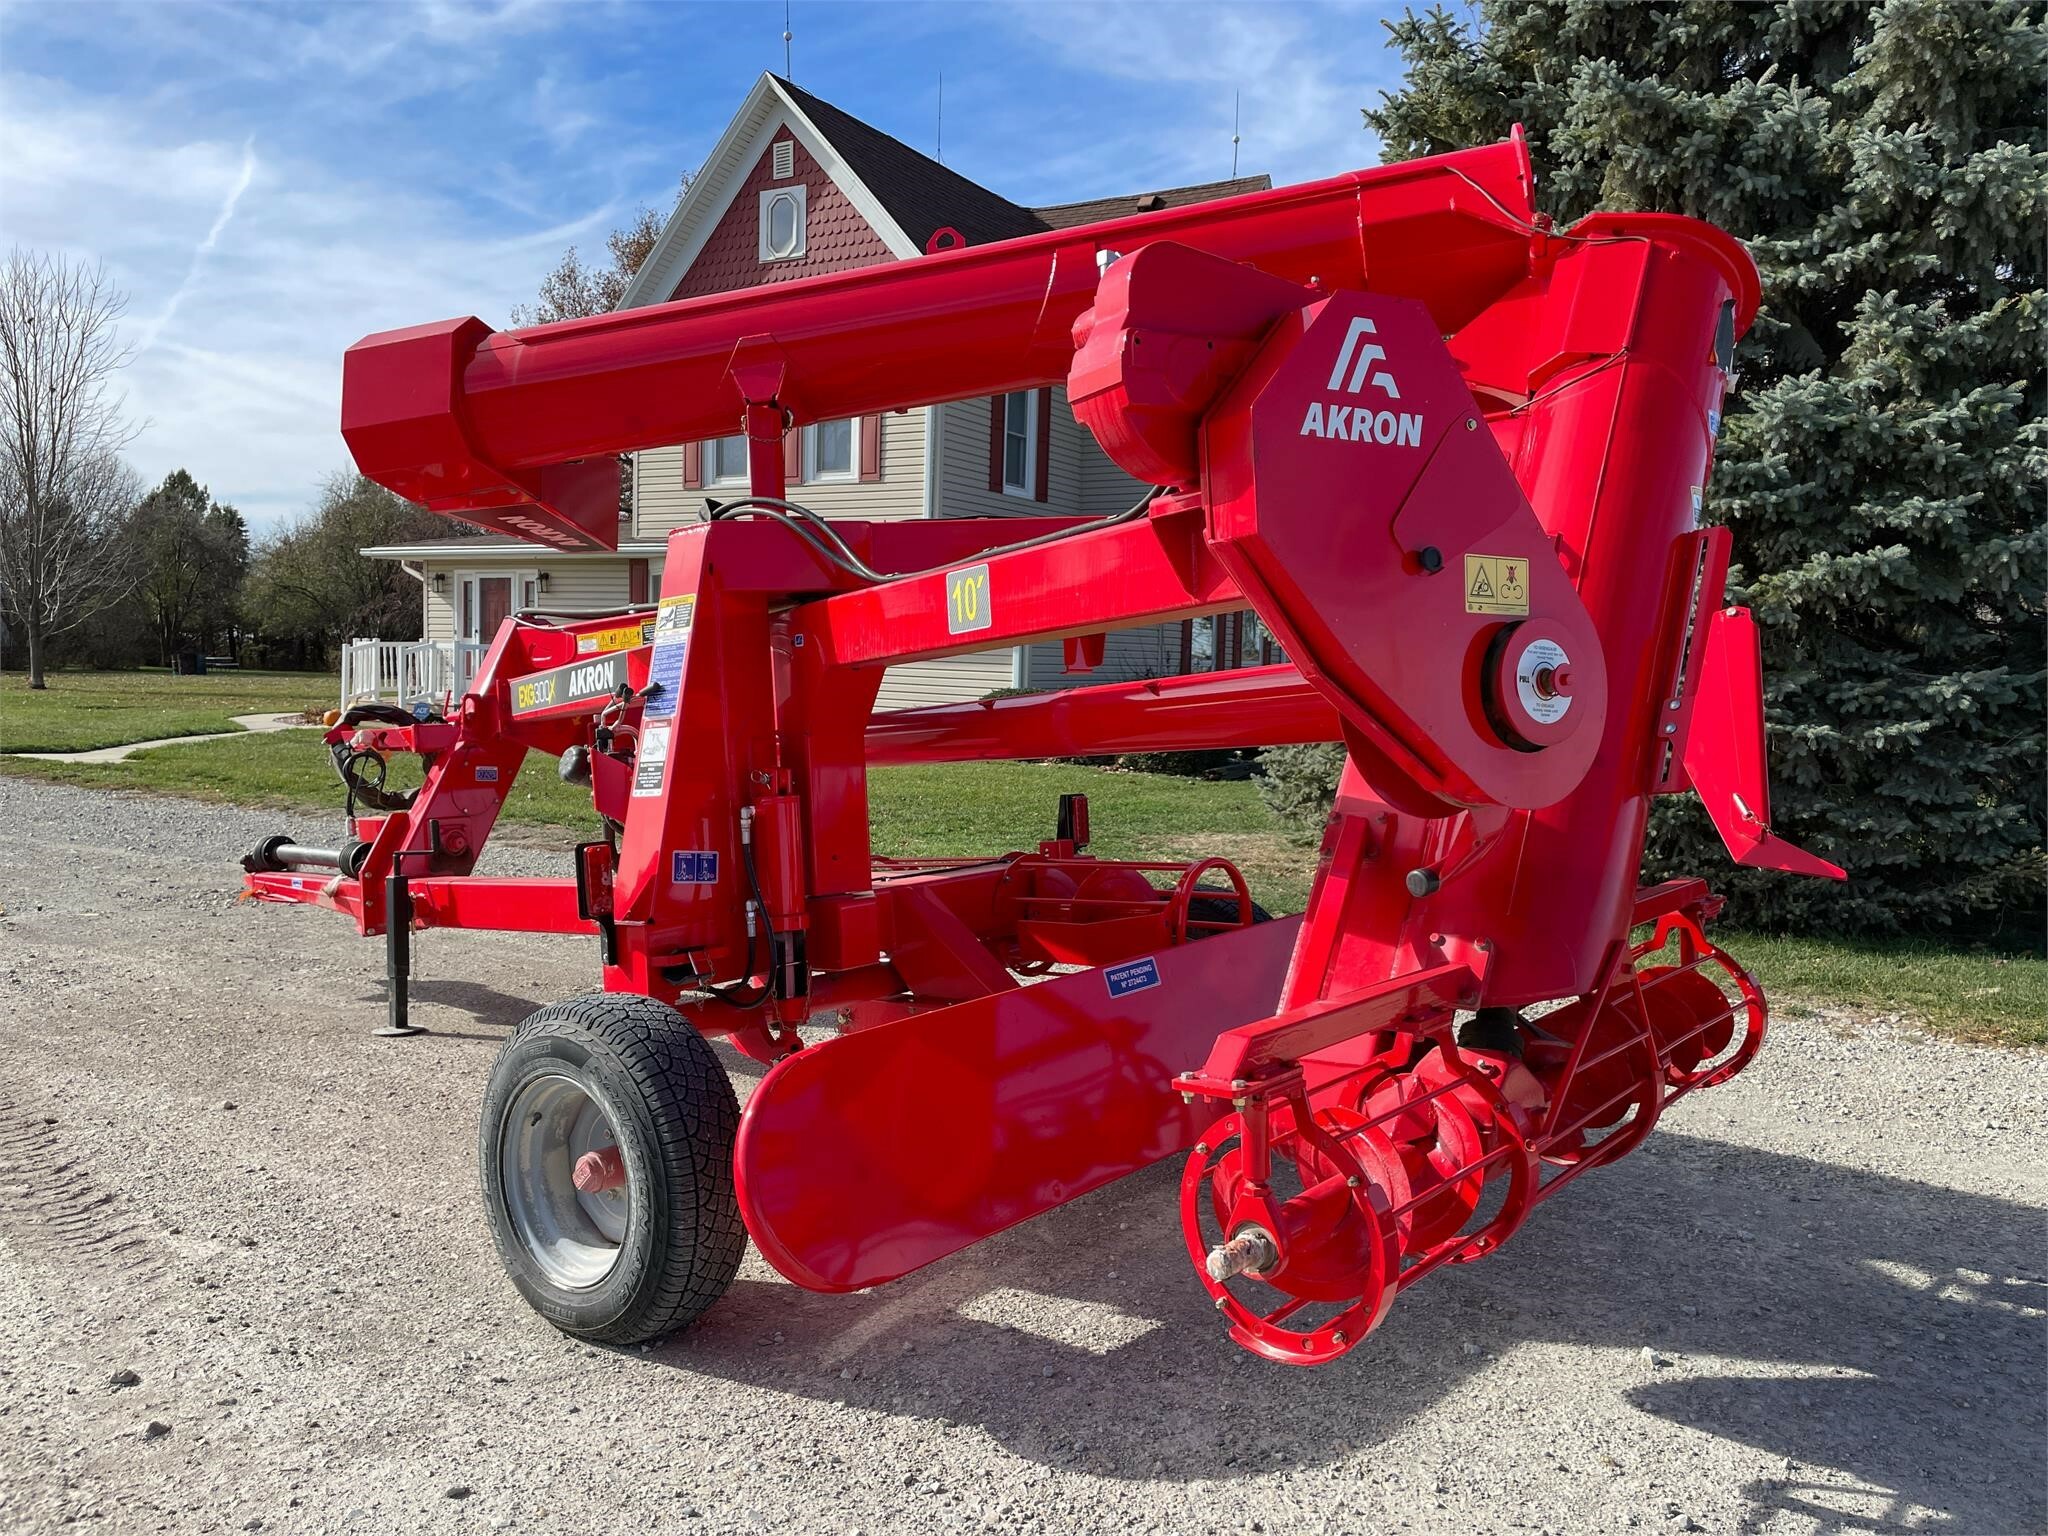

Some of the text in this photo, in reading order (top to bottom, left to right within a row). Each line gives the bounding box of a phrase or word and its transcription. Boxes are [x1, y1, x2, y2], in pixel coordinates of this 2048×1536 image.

[1300, 402, 1424, 447] AKRON
[497, 515, 589, 546] AKRON
[518, 674, 557, 708] EXG300X
[569, 661, 614, 697] AKRON
[1110, 964, 1153, 982] PATENT PENDING
